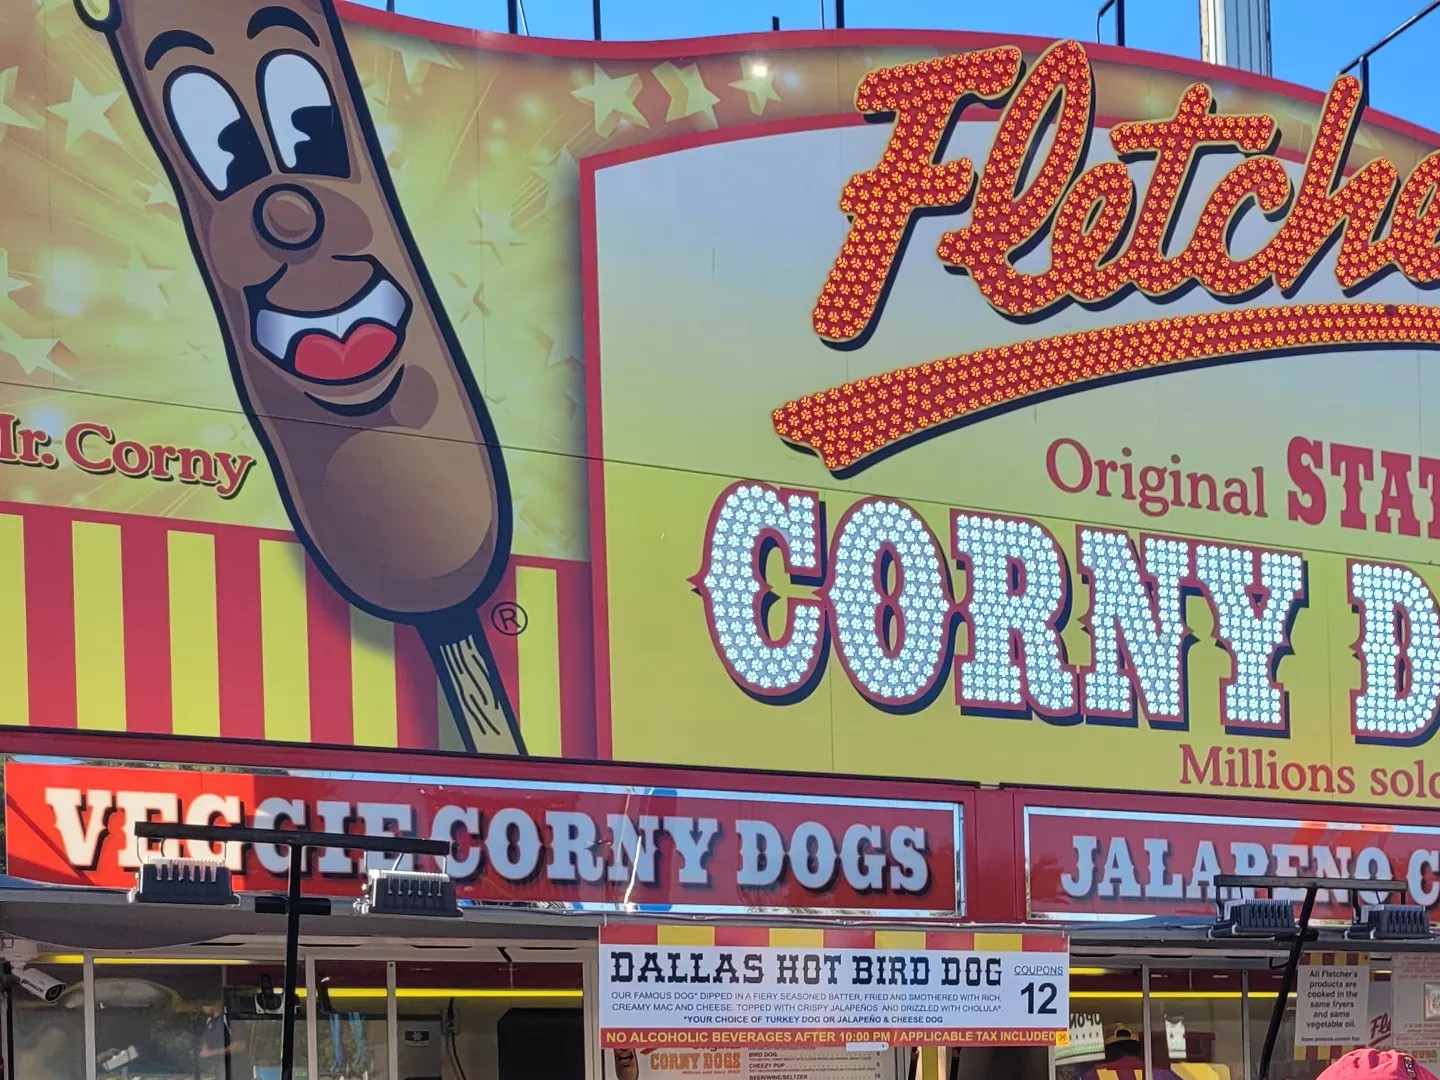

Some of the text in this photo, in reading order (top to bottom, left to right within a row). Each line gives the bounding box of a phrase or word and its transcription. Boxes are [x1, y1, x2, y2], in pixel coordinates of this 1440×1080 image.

[65, 422, 257, 500] Corny
[1046, 437, 1266, 521] Original
[690, 479, 1310, 740] CORNY
[1180, 743, 1356, 796] Millions
[432, 804, 724, 887] CORNY
[735, 819, 932, 896] DOGS
[611, 952, 1002, 987] DALLAS HOT BIRD DOG
[1014, 965, 1064, 976] COUPONS
[1322, 970, 1358, 978] Fletcher's
[1309, 981, 1343, 989] products
[611, 991, 632, 1000] OUR
[634, 991, 672, 1000] FAMOUS
[700, 992, 733, 1000] DIPPED
[735, 992, 744, 1000] IN
[745, 992, 751, 1000] A
[753, 992, 778, 1001] FIERY
[780, 992, 826, 1001] SEASONED
[864, 993, 888, 1001] FRIED
[890, 993, 907, 1001] AND
[908, 993, 958, 1002] SMOTHERED
[960, 993, 980, 1001] WITH
[1020, 982, 1058, 1015] 12
[612, 1003, 650, 1012] CREAMY
[652, 1003, 673, 1012] MAC
[674, 1003, 692, 1012] AND
[736, 1003, 771, 1012] TOPPED
[774, 1003, 796, 1012] WITH
[797, 1003, 827, 1012] CRISPY
[830, 1002, 878, 1012] JALAPEÑOS
[882, 1004, 899, 1012] AND
[901, 1004, 939, 1012] DRIZZLED
[941, 1004, 960, 1012] WITH
[1332, 1001, 1354, 1009] fryers
[715, 1015, 748, 1024] CHOICE
[750, 1015, 763, 1024] OF
[766, 1015, 800, 1024] TURKEY
[802, 1015, 820, 1024] DOG
[822, 1015, 835, 1024] OR
[837, 1014, 881, 1024] JALAPEÑO
[883, 1015, 889, 1024] &
[891, 1015, 924, 1024] CHEESE
[925, 1015, 943, 1024] DOG
[1306, 1020, 1356, 1029] vegetable oil.
[606, 1032, 627, 1043] NO
[630, 1032, 708, 1043] ALCOHOLIC
[712, 1032, 791, 1043] BEVERAGES
[795, 1032, 835, 1042] AFTER
[839, 1032, 870, 1042] 10:00
[873, 1032, 891, 1042] PM
[900, 1031, 973, 1042] APPLICABLE
[976, 1031, 997, 1041] TAX
[1000, 1031, 1056, 1042] INCLUDED
[650, 1053, 741, 1070] CORNY DOGS
